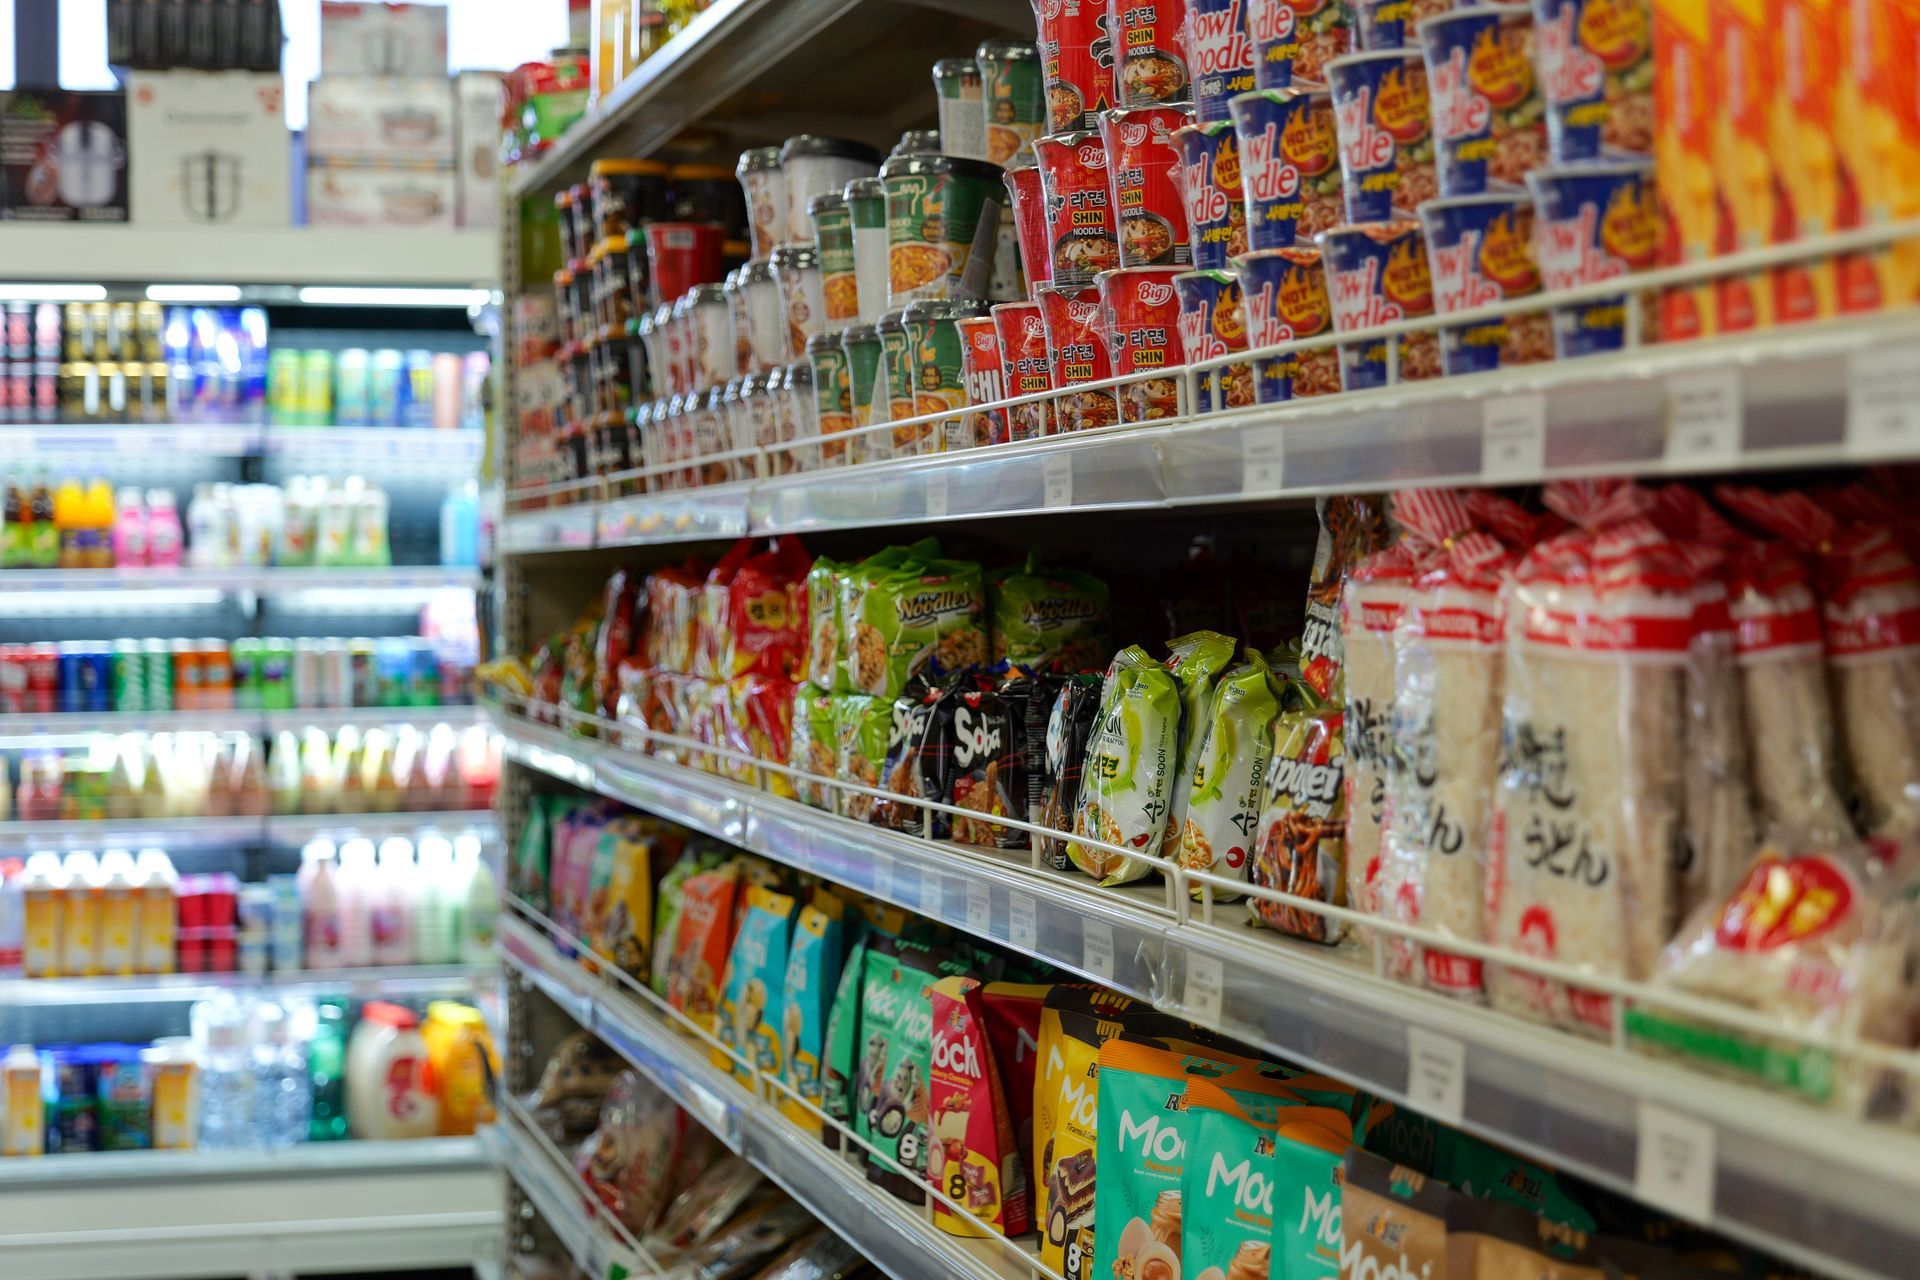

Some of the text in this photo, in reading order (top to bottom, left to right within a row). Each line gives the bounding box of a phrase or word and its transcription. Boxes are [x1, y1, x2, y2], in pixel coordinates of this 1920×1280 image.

[1125, 6, 1156, 27] 라면
[1128, 28, 1153, 44] SHIN
[1128, 45, 1155, 56] NOODLE
[1227, 76, 1255, 91] 사발
[1121, 123, 1140, 145] Big
[1286, 128, 1314, 146] HOT
[1080, 146, 1105, 166] Big
[1118, 168, 1143, 188] 라면
[1070, 190, 1106, 210] 라면
[1121, 191, 1143, 204] SHIN
[1194, 187, 1225, 223] dle
[1073, 212, 1103, 225] SHIN
[1122, 207, 1143, 216] NOODLE
[1073, 227, 1104, 235] NOODLE
[1138, 281, 1165, 303] Big
[1069, 301, 1092, 322] Big
[975, 332, 992, 349] Big
[1131, 329, 1166, 346] 라면
[1063, 345, 1095, 362] 라면
[1134, 350, 1164, 364] SHIN
[1018, 358, 1049, 374] 라면
[1066, 365, 1092, 377] SHIN
[1021, 377, 1047, 390] SHIN
[901, 591, 970, 619] Noodles
[889, 701, 925, 749] Soba
[954, 706, 1001, 768] Soba
[1157, 749, 1166, 776] SOON
[1251, 757, 1263, 786] SOON
[1060, 1075, 1097, 1130] Mo
[1119, 1109, 1186, 1160] Mo
[901, 1133, 918, 1159] 8
[950, 1174, 966, 1199] 8
[1068, 1243, 1081, 1273] 8
